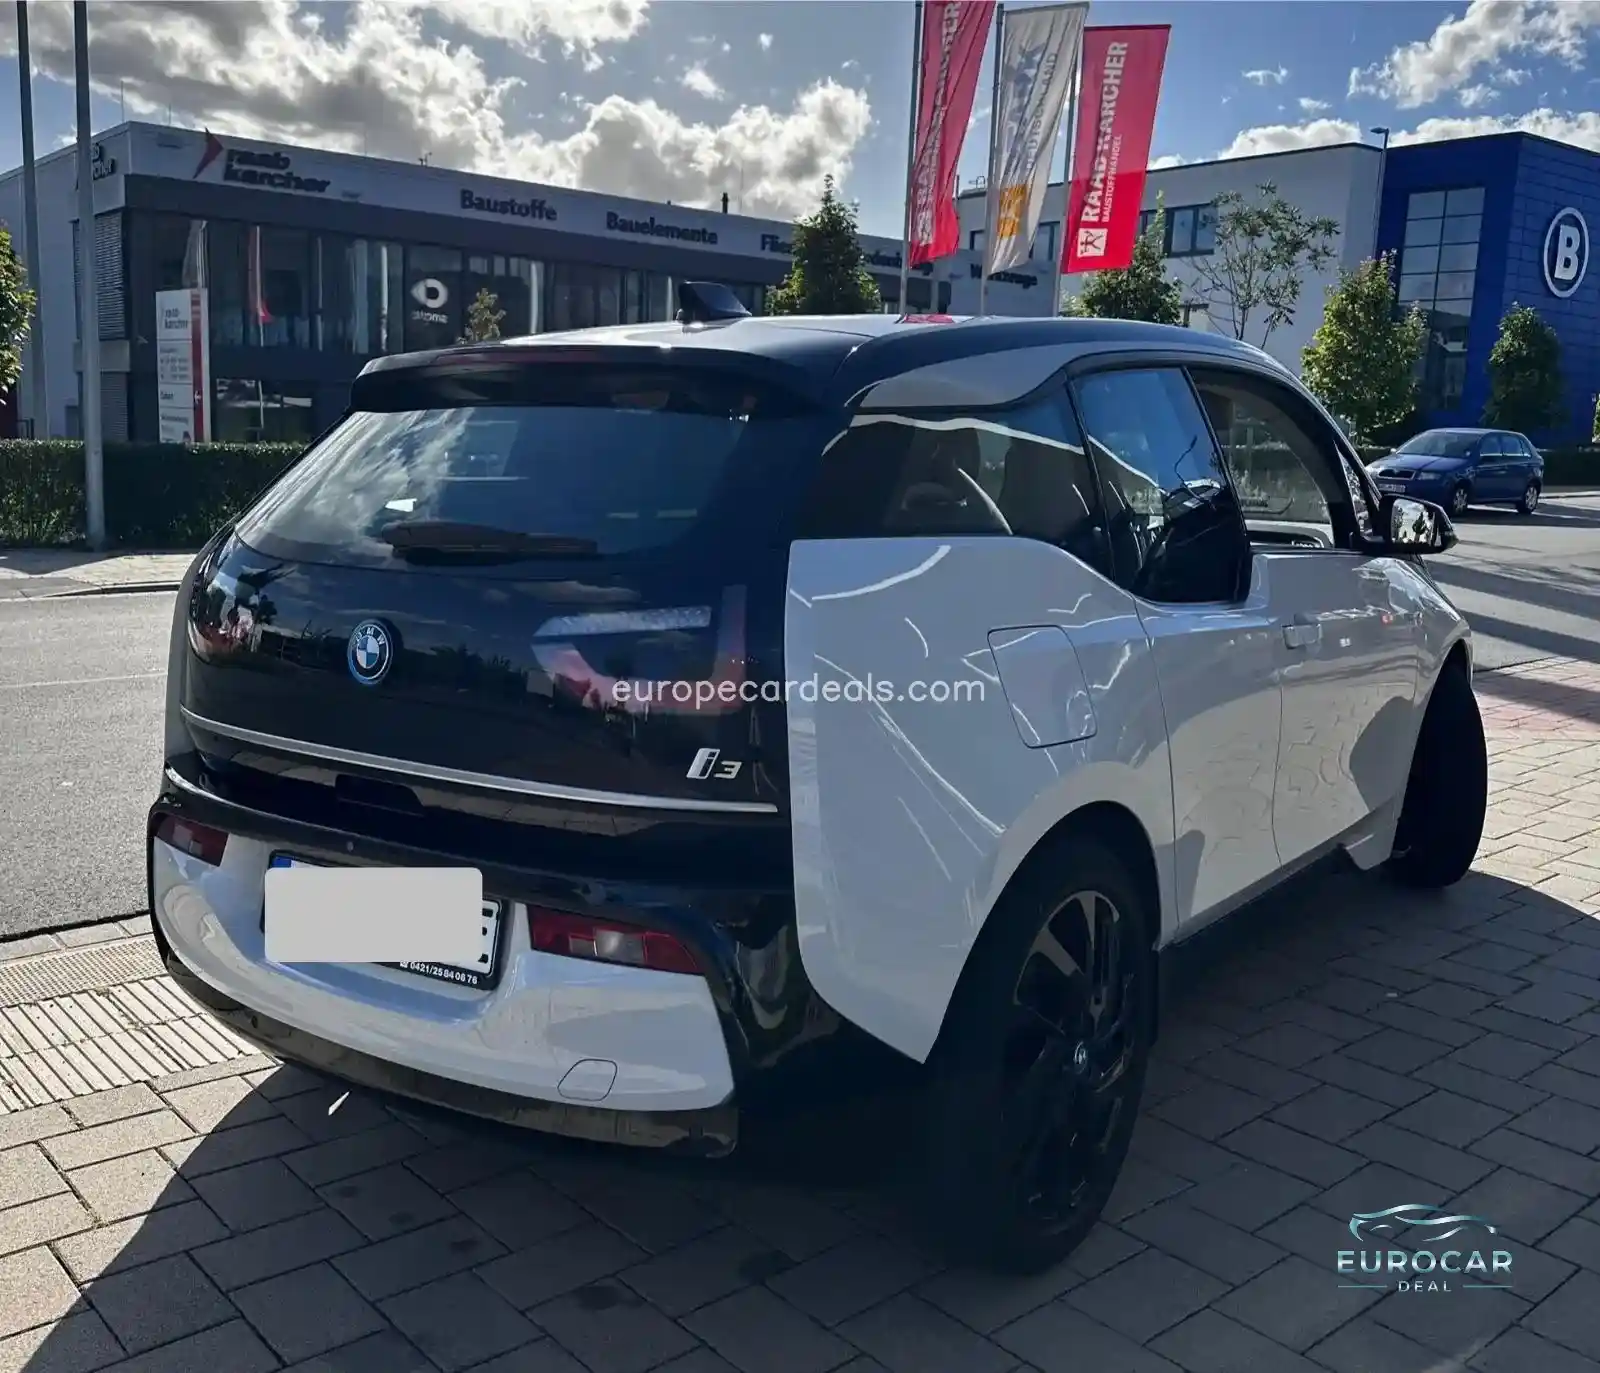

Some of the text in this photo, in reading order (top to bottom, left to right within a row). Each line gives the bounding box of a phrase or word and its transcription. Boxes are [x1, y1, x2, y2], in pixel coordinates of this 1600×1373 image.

[223, 162, 331, 193] karcher
[460, 189, 557, 221] Baustoffe
[606, 211, 718, 245] Bauelemente
[1554, 224, 1580, 280] B
[687, 748, 742, 780] i3
